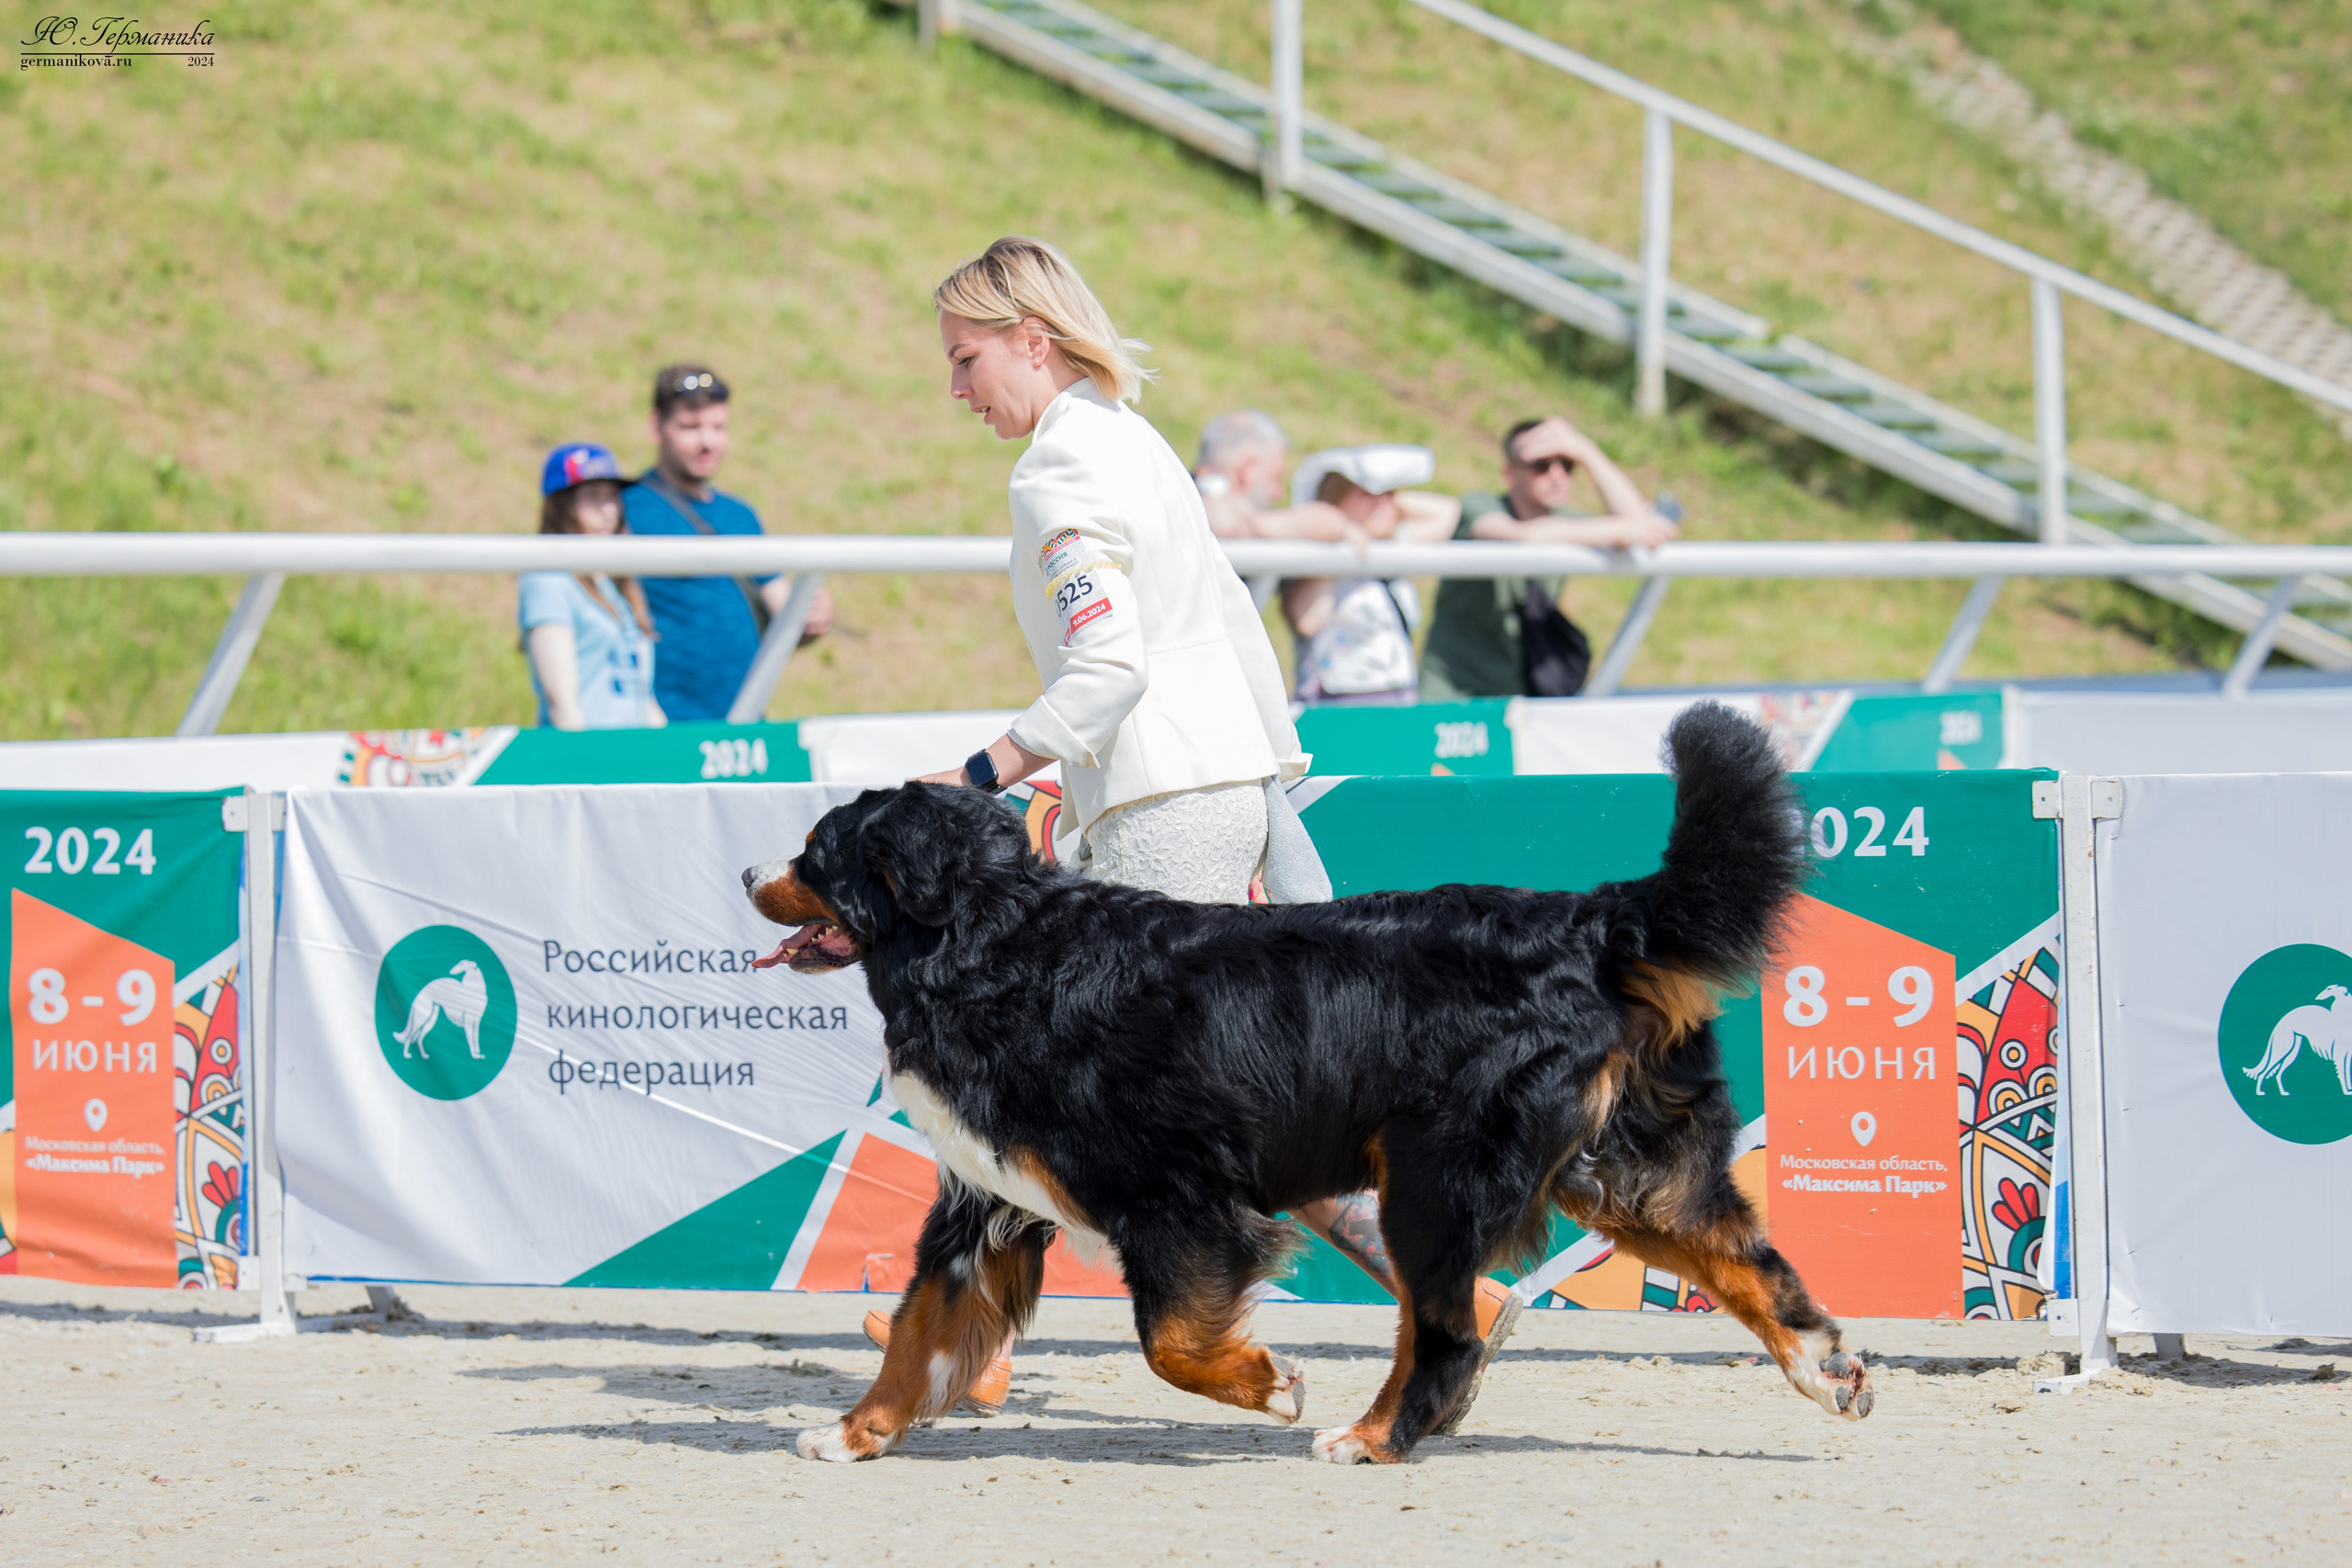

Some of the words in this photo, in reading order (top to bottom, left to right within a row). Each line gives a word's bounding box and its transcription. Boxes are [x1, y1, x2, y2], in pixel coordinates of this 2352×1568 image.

[699, 738, 769, 779] 2024
[24, 827, 156, 874] 2024
[544, 940, 758, 973] Российская
[548, 1004, 848, 1030] кинологическая
[33, 1039, 156, 1073] ИЮНЯ
[548, 1049, 754, 1095] федерация
[1788, 1045, 1936, 1080] ИЮНЯ
[25, 1135, 106, 1153] Московская
[108, 1138, 166, 1156] область,
[26, 1154, 109, 1173] «Максима
[112, 1156, 164, 1179] Парк»
[1780, 1155, 1876, 1169] Московская
[1880, 1155, 1948, 1172] область,
[1781, 1174, 1882, 1192] «Максима
[1885, 1175, 1947, 1198] Парк»
